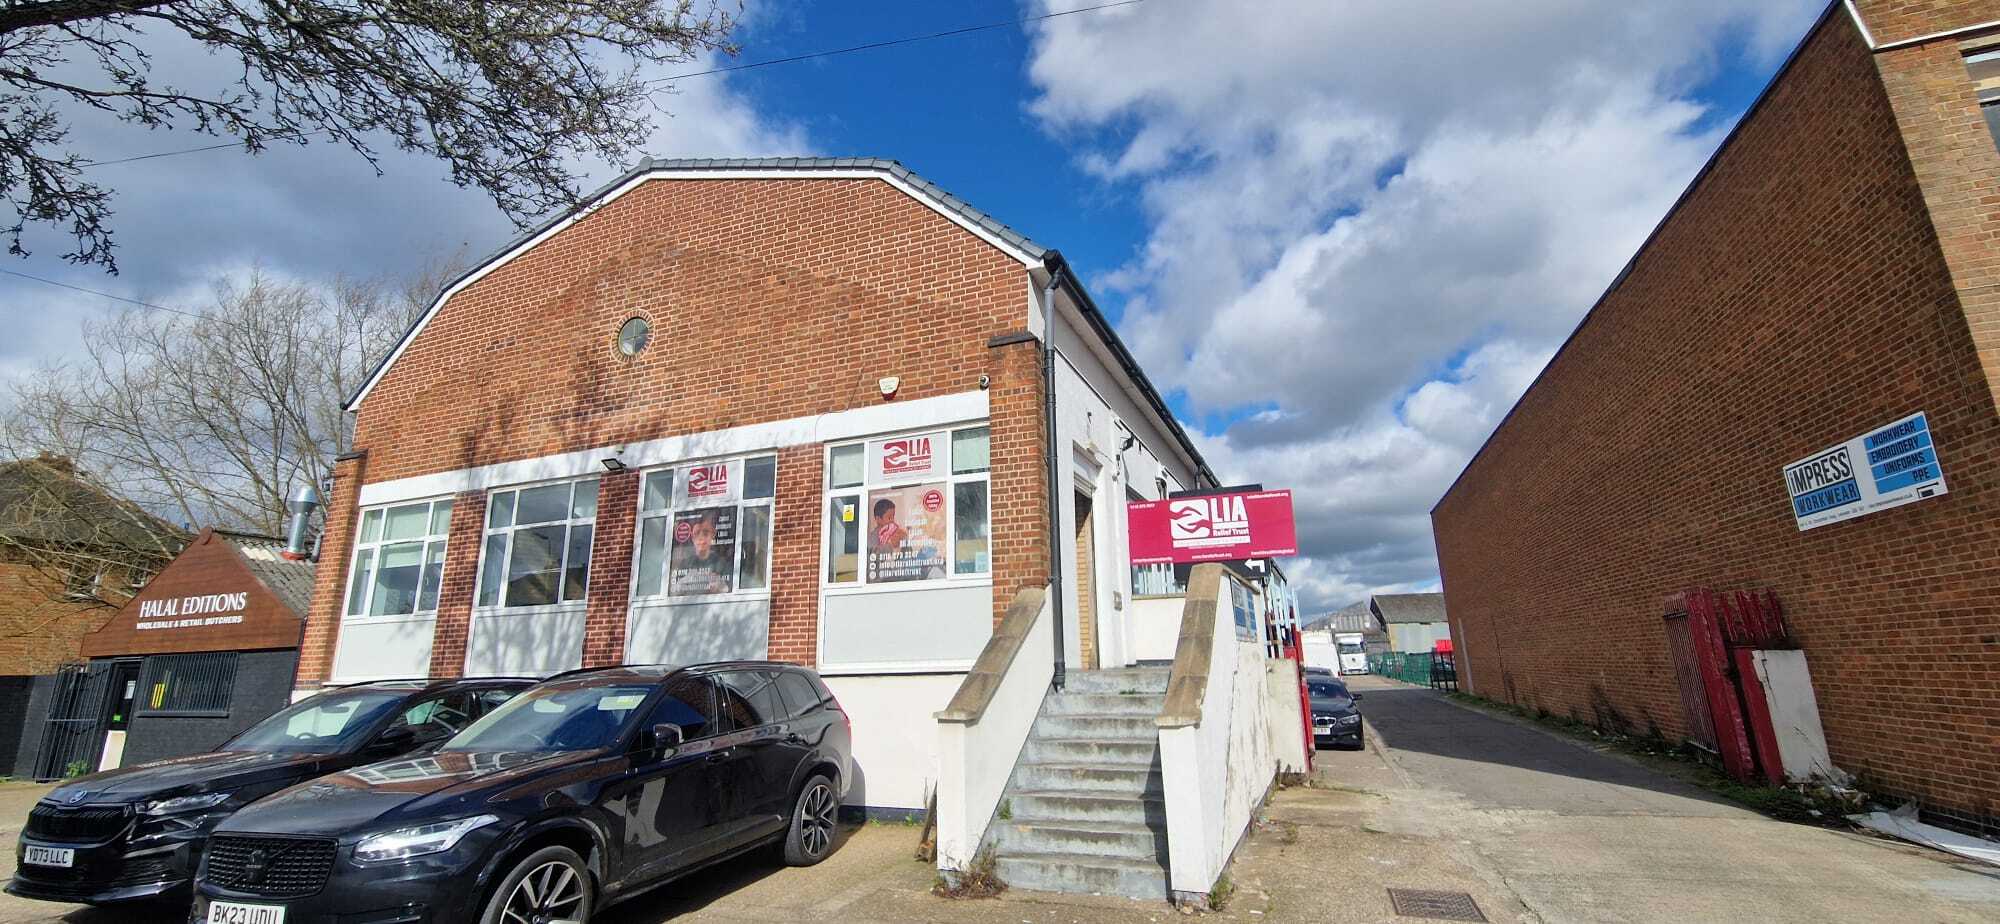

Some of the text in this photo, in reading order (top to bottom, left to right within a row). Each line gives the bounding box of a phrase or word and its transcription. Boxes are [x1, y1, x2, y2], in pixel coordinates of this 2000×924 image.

[1871, 421, 1917, 446] WORKWEAR
[909, 438, 931, 457] LIA
[1871, 437, 1919, 463] EMBROIDERY
[709, 465, 728, 482] LIA
[1790, 452, 1852, 494] iMPRESS
[1883, 452, 1925, 474] UNIFORMS
[1912, 467, 1931, 481] PPE
[1210, 495, 1248, 523] LIA
[1796, 484, 1857, 513] WORKWEAR
[1212, 527, 1249, 536] Relief Trust
[139, 591, 247, 618] HALAL EDITIONS
[136, 620, 172, 630] WHOLESALE
[180, 618, 203, 627] RETAIL
[205, 615, 243, 625] BUTCHERS
[50, 850, 69, 865] LLC
[213, 904, 245, 924] BK23
